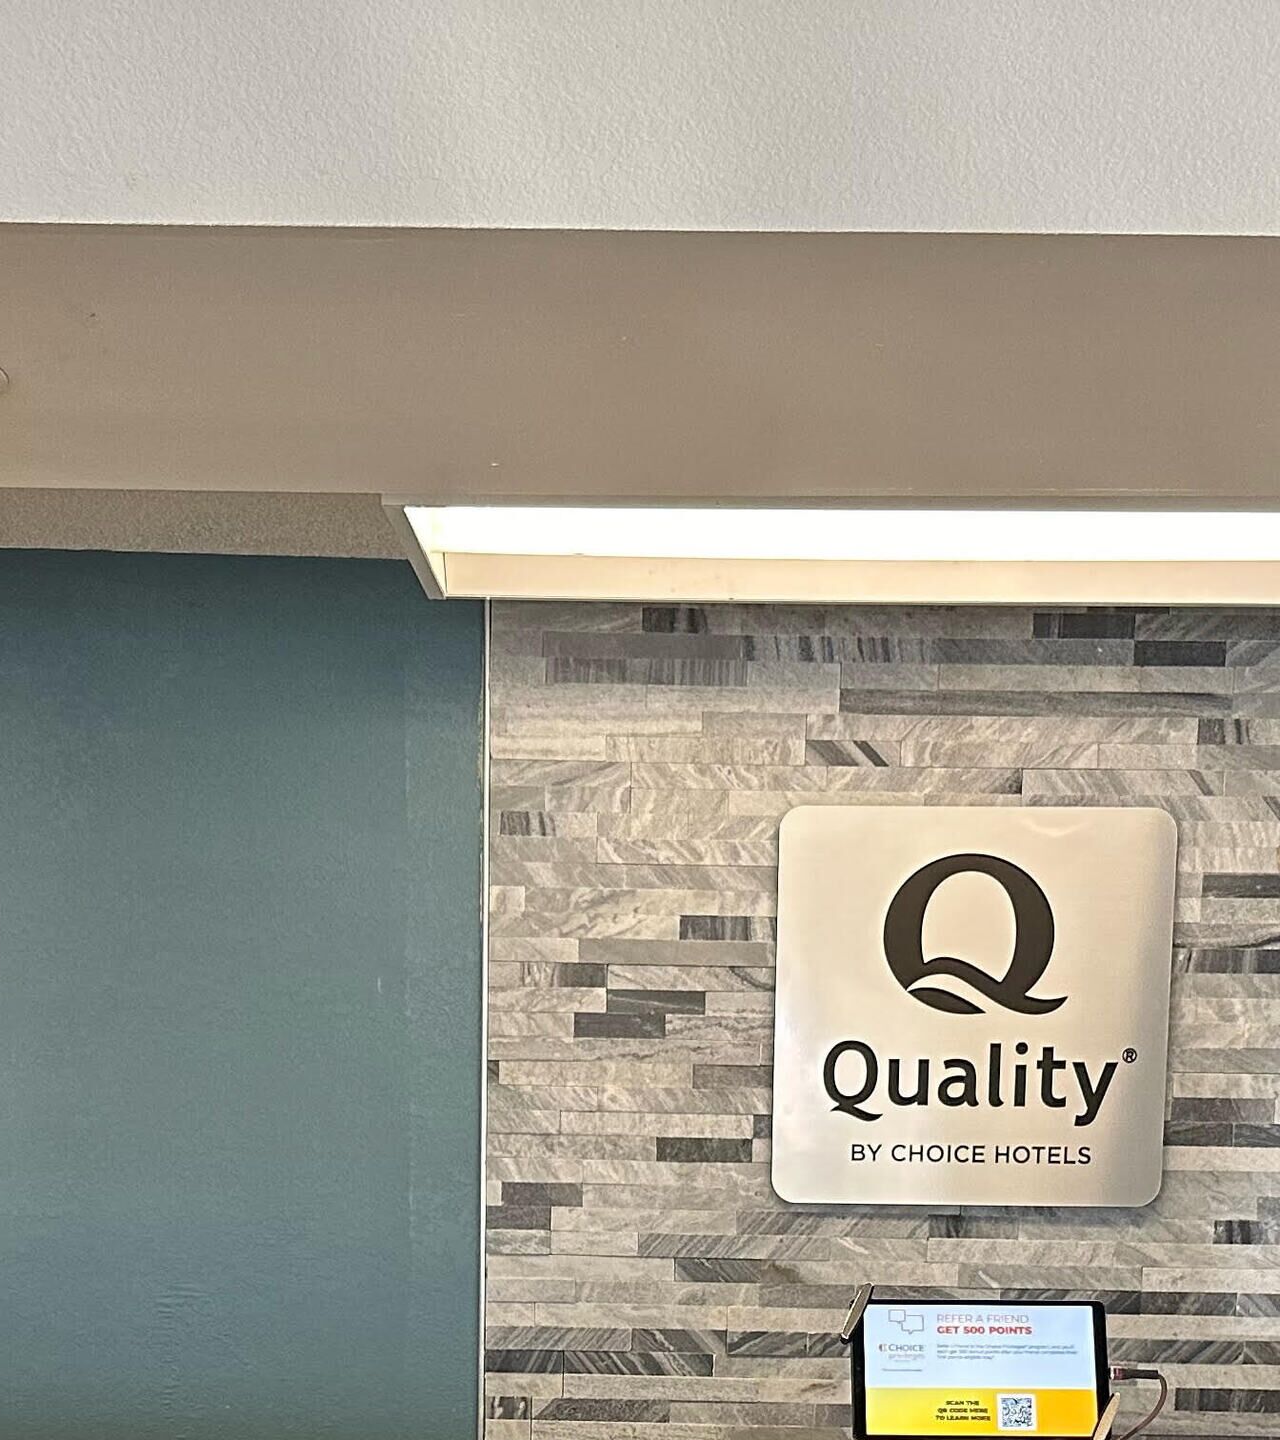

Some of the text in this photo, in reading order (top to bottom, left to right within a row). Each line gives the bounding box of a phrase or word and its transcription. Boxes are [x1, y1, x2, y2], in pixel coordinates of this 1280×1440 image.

[883, 852, 1069, 1015] Q
[850, 1143, 1092, 1165] BY CHOICE HOTELS
[936, 1313, 1030, 1324] REFER A FRIEND
[936, 1325, 1033, 1336] GET 500 POINTS
[888, 1343, 924, 1352] CHOICE
